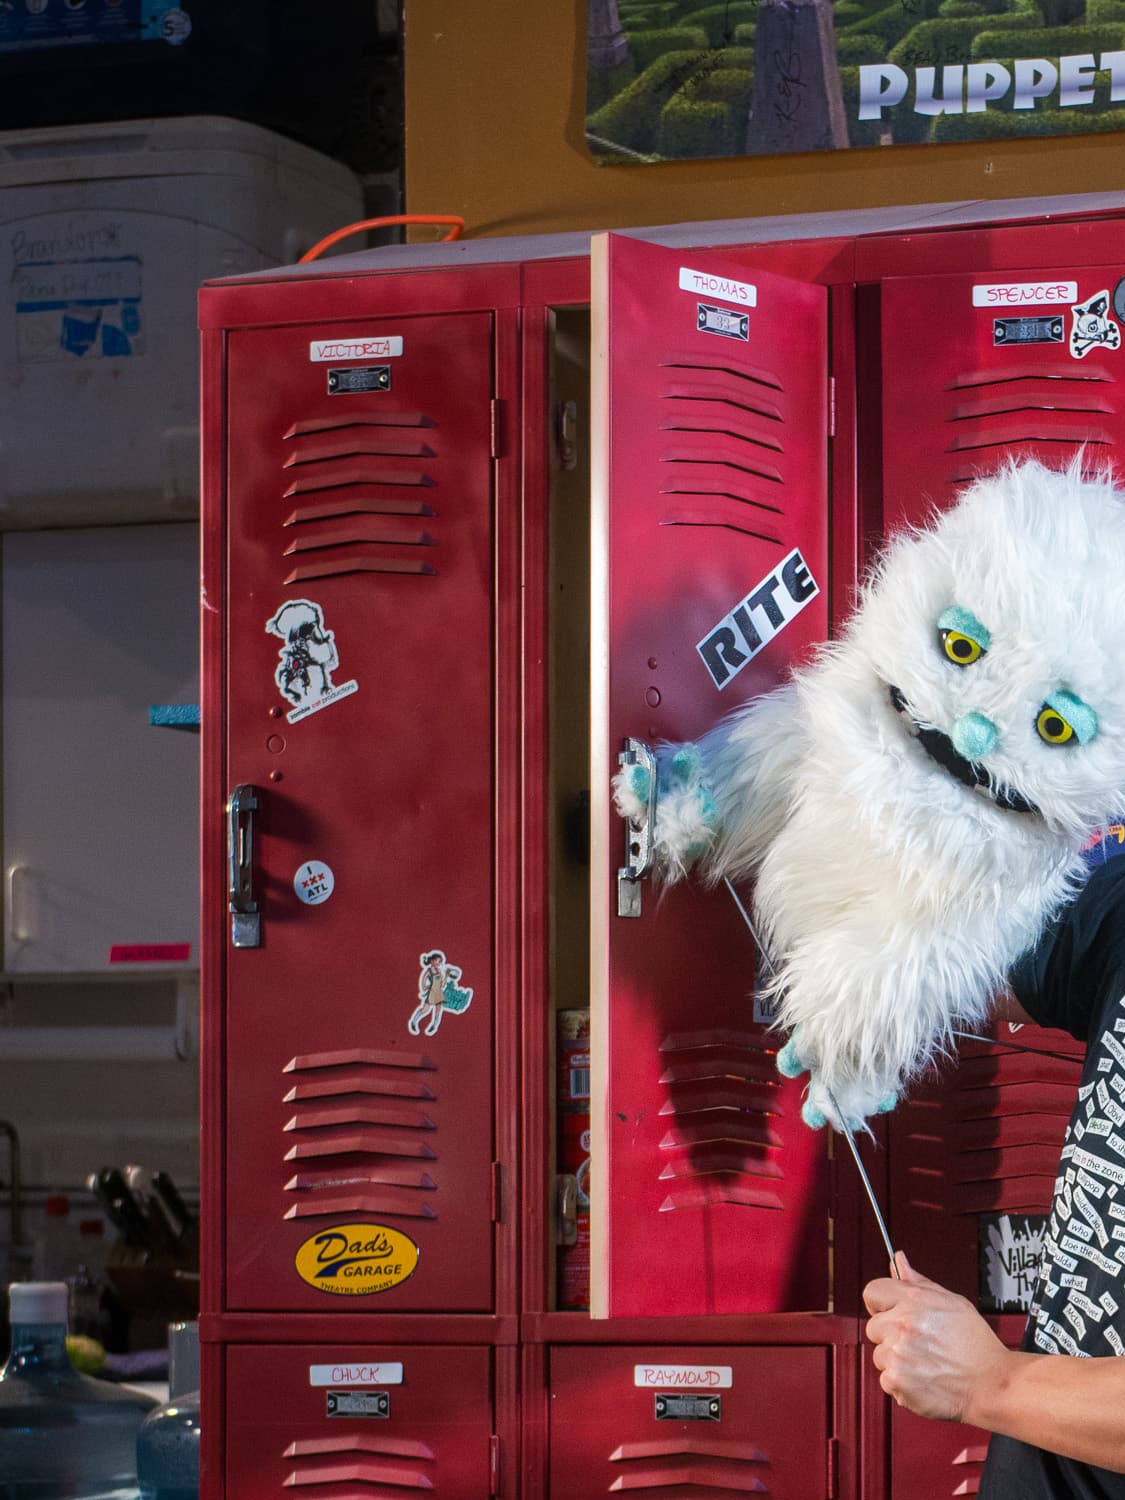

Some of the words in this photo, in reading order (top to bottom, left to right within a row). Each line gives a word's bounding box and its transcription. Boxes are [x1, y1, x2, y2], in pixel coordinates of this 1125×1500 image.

[693, 275, 748, 300] THOMAS
[987, 285, 1069, 303] SPENCER
[316, 340, 390, 358] VICTORIA
[699, 552, 817, 686] RITE
[308, 883, 328, 898] ATL
[1086, 1157, 1101, 1171] the
[1099, 1166, 1124, 1182] zone
[1071, 1223, 1089, 1239] who
[315, 1232, 394, 1263] Dad's
[1064, 1240, 1079, 1251] Joe
[344, 1264, 402, 1277] GARAGE
[321, 1282, 354, 1294] THEATRE
[356, 1280, 393, 1294] COMPANY
[1065, 1278, 1084, 1286] what
[1103, 1297, 1115, 1312] can
[331, 1367, 381, 1383] CHUCK
[644, 1369, 721, 1386] RAYMOND
